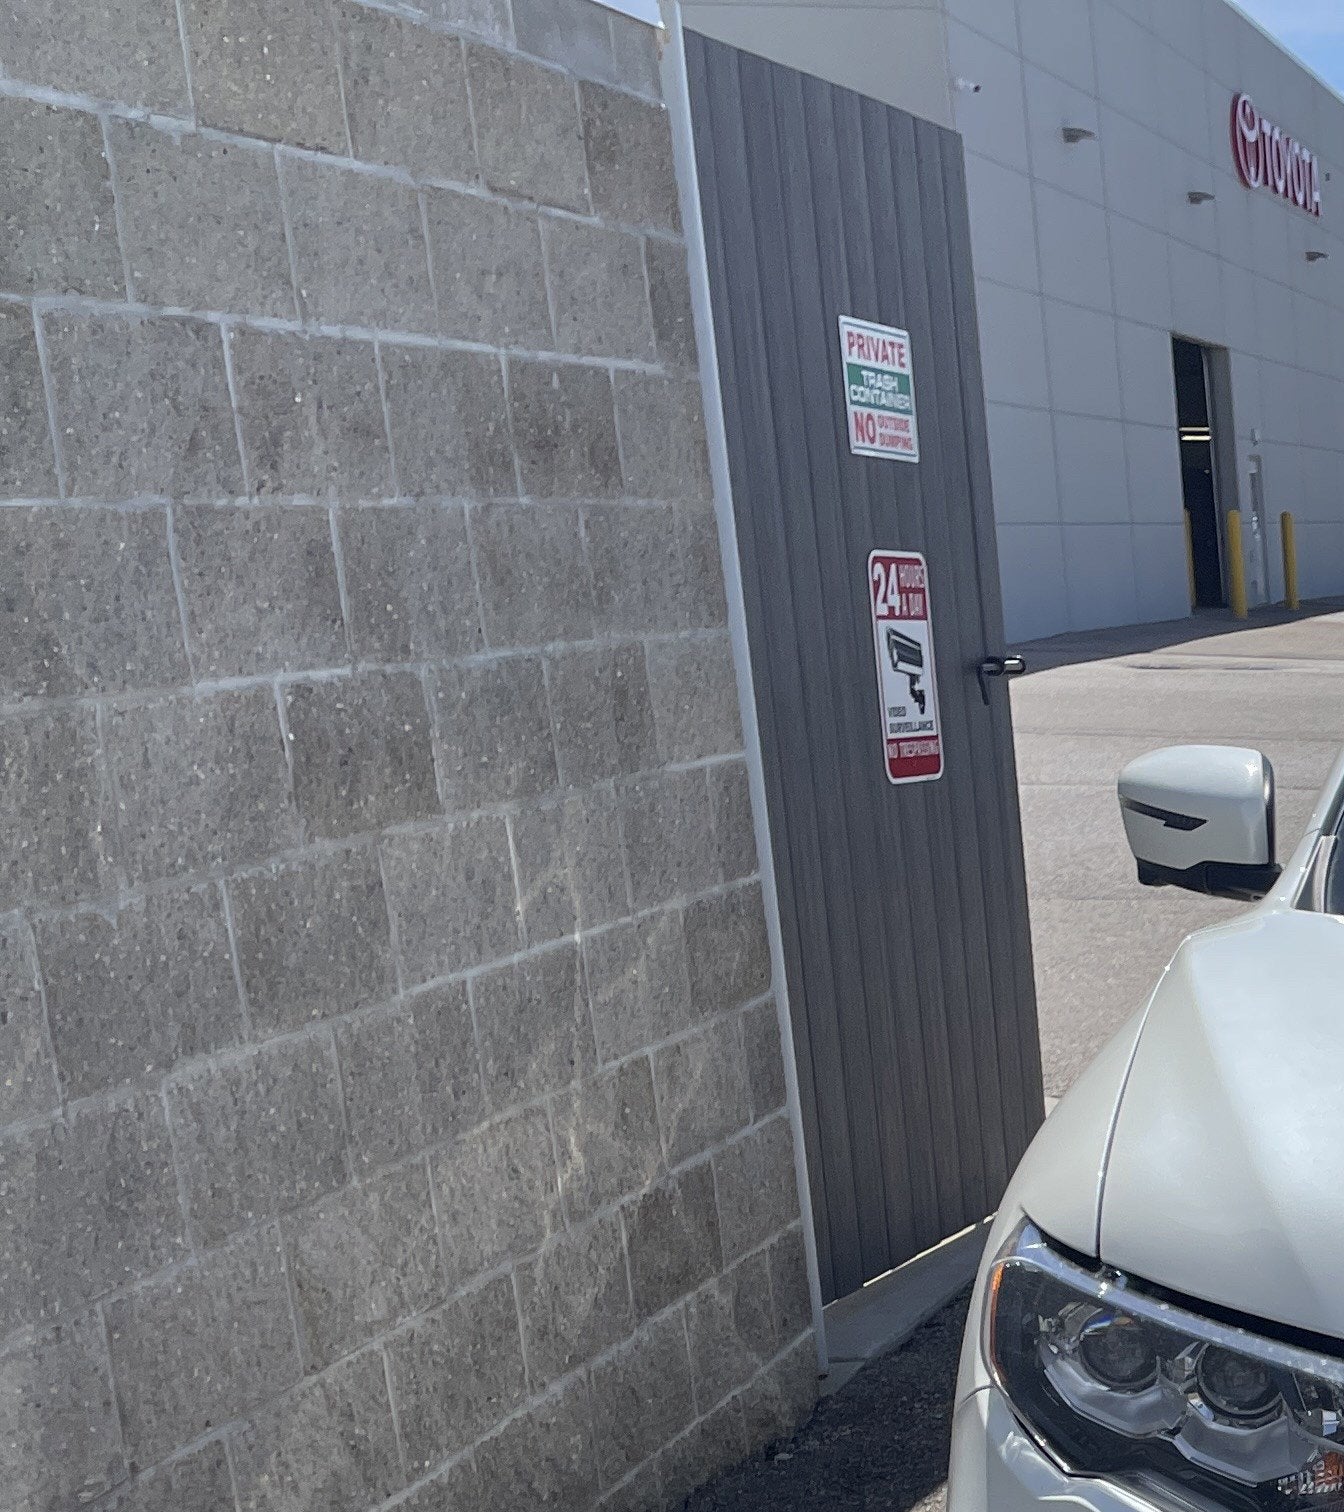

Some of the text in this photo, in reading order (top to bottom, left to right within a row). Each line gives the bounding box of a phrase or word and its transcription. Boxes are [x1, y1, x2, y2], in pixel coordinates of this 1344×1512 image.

[1259, 117, 1323, 217] TOYOTA
[846, 331, 906, 368] PRIVATE
[853, 411, 877, 444] NO
[872, 562, 901, 616] 24
